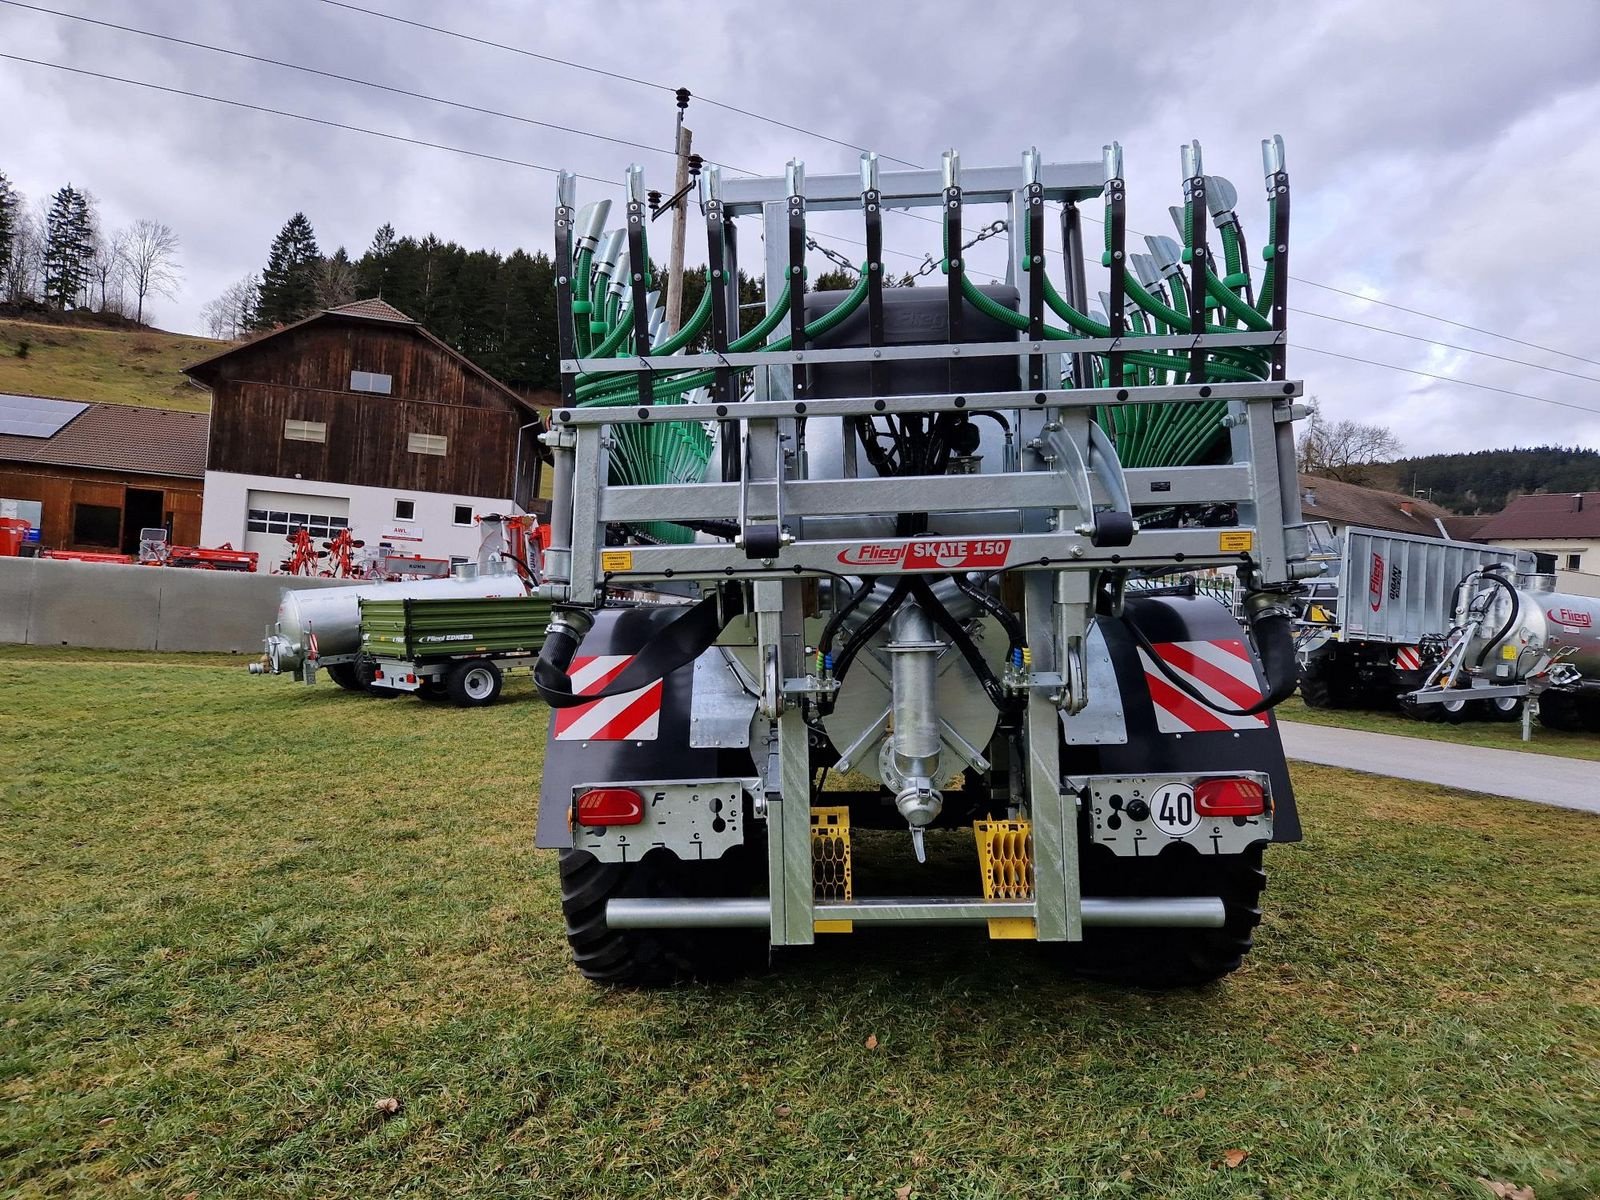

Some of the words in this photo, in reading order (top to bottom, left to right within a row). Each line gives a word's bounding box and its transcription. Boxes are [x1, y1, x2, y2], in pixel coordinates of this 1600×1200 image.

[858, 544, 907, 562] Fliegl
[914, 542, 967, 557] SKATE
[973, 541, 1005, 556] 150
[1371, 552, 1384, 595] Fliegl
[1390, 564, 1399, 600] GIGANT
[1560, 608, 1592, 626] Fliegl
[652, 792, 666, 807] F
[1159, 792, 1192, 826] 40
